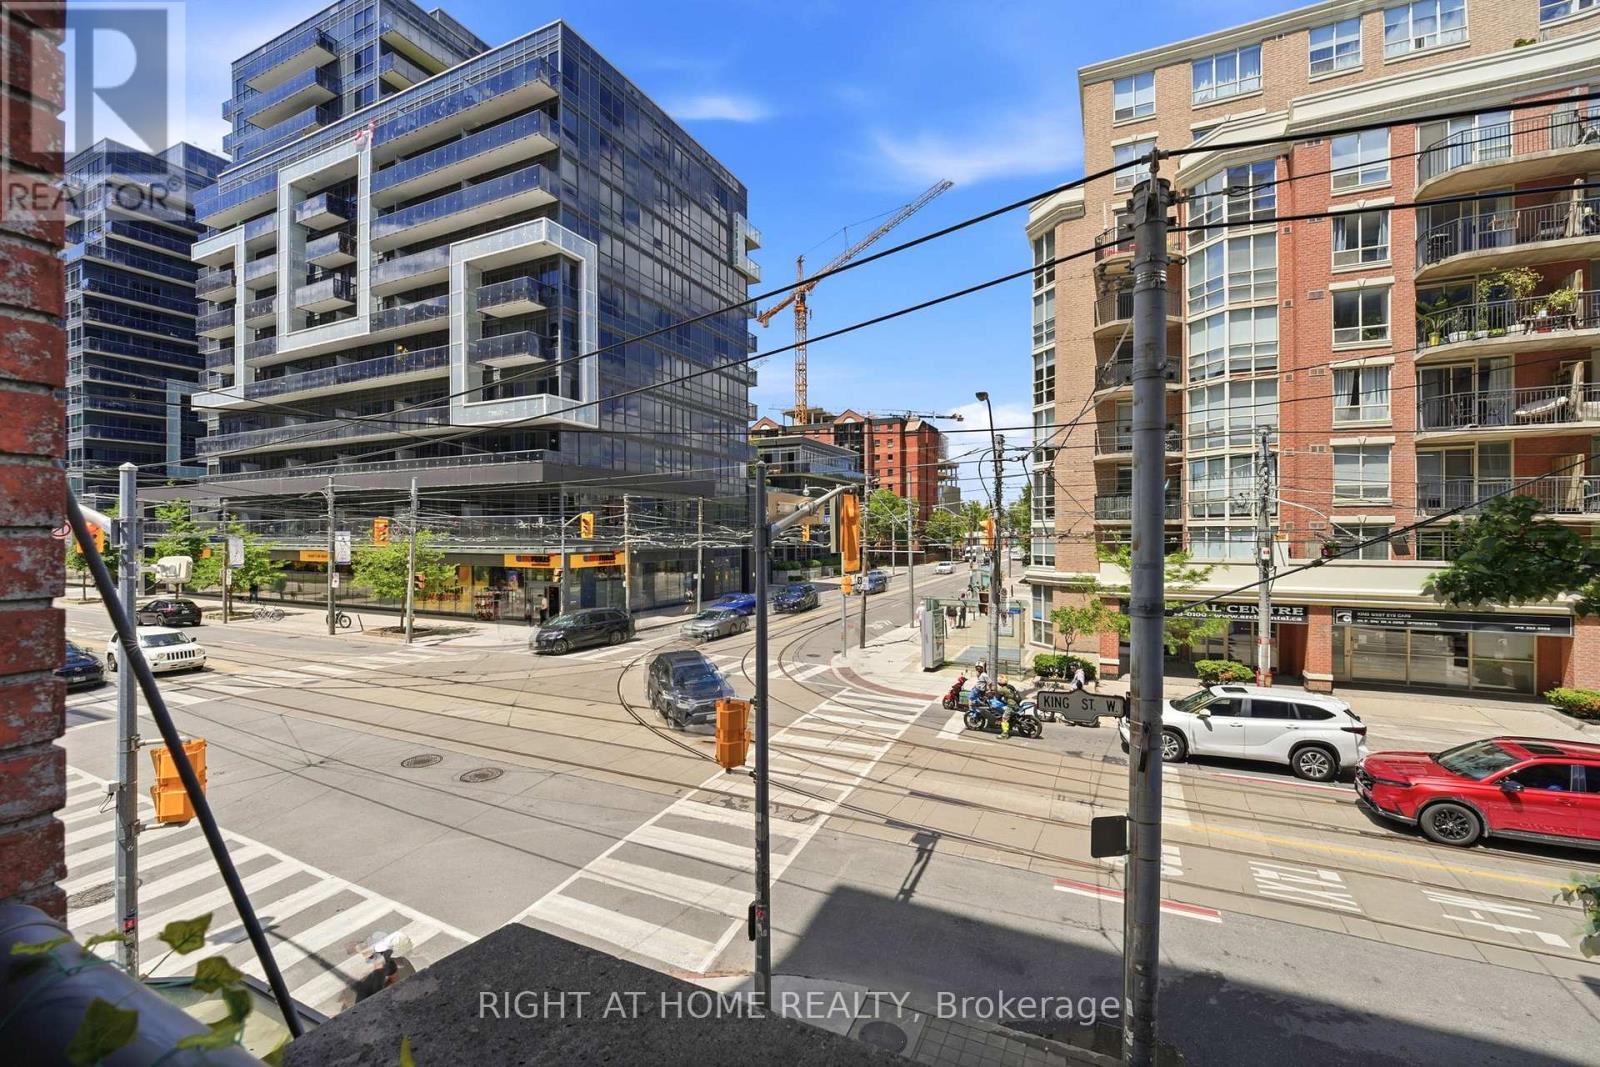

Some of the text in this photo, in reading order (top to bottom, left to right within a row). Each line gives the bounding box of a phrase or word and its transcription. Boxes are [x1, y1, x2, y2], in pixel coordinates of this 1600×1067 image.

[1213, 613, 1303, 622] www.archntal.ca
[1043, 695, 1119, 713] KING ST. W.
